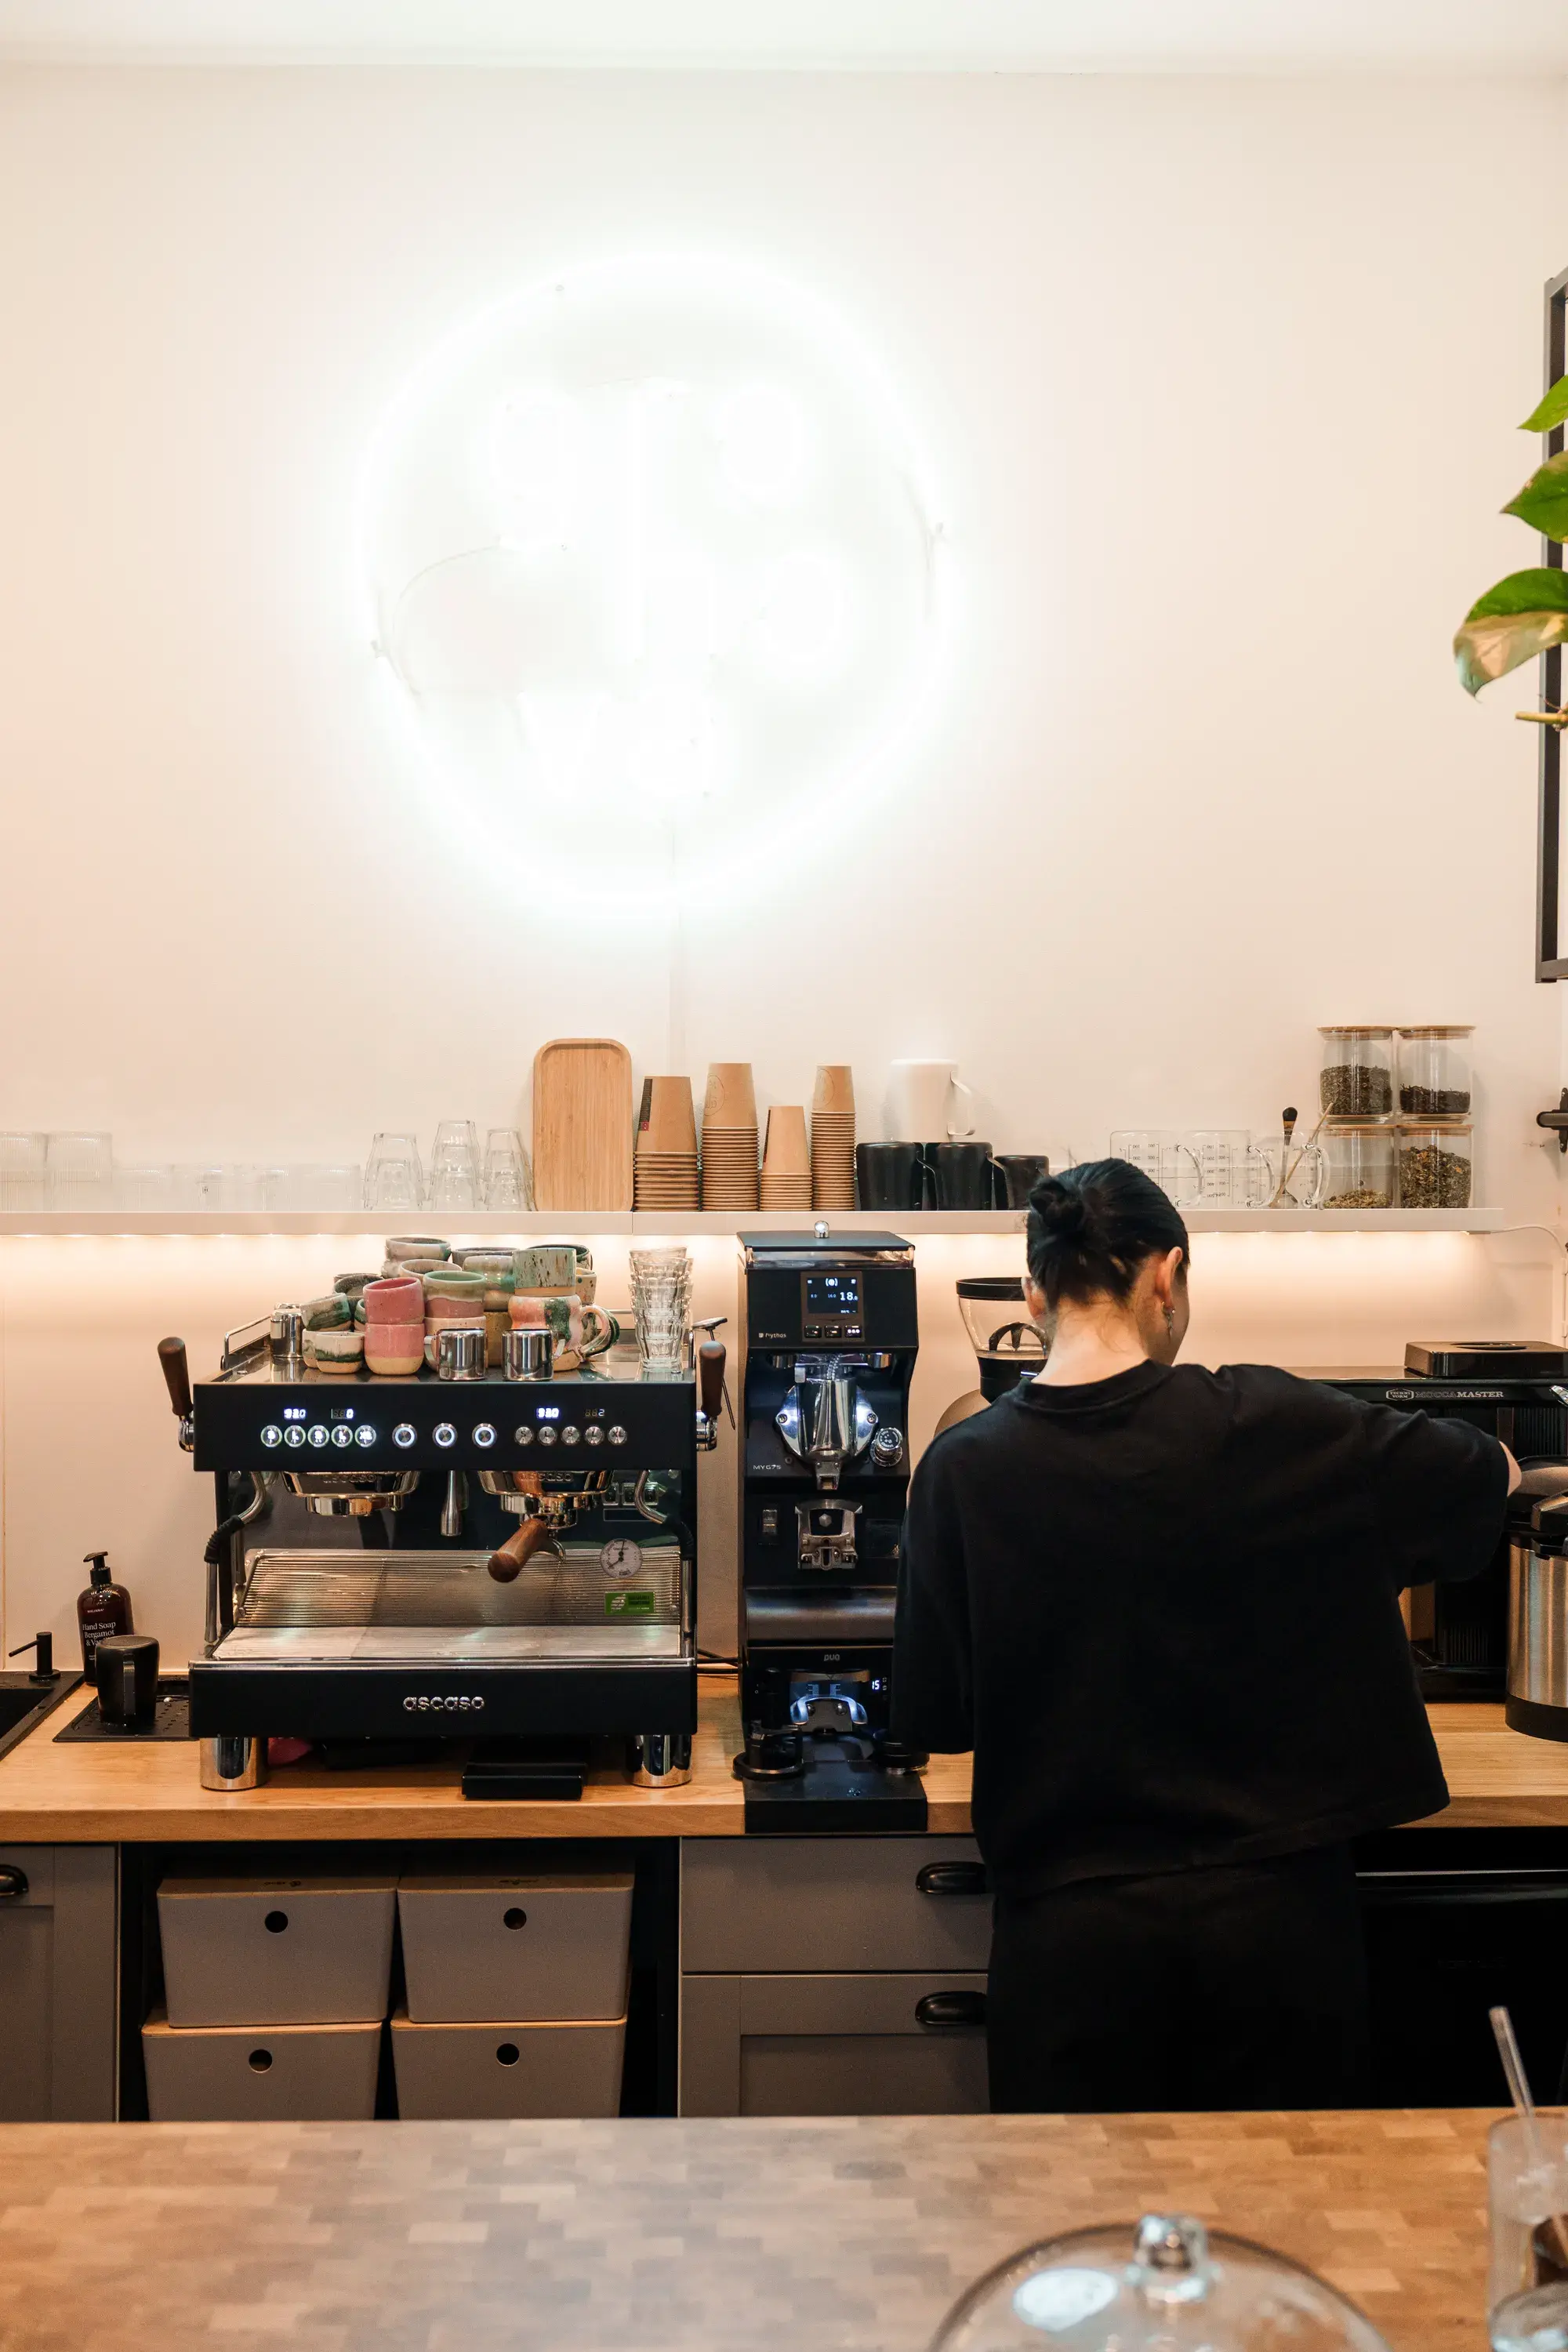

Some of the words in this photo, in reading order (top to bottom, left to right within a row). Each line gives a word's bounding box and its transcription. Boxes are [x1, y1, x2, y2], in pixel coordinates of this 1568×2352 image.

[840, 1291, 858, 1301] 18.0
[84, 1629, 115, 1639] Bergamot
[872, 1680, 880, 1690] 15
[403, 1697, 485, 1711] ascaso
